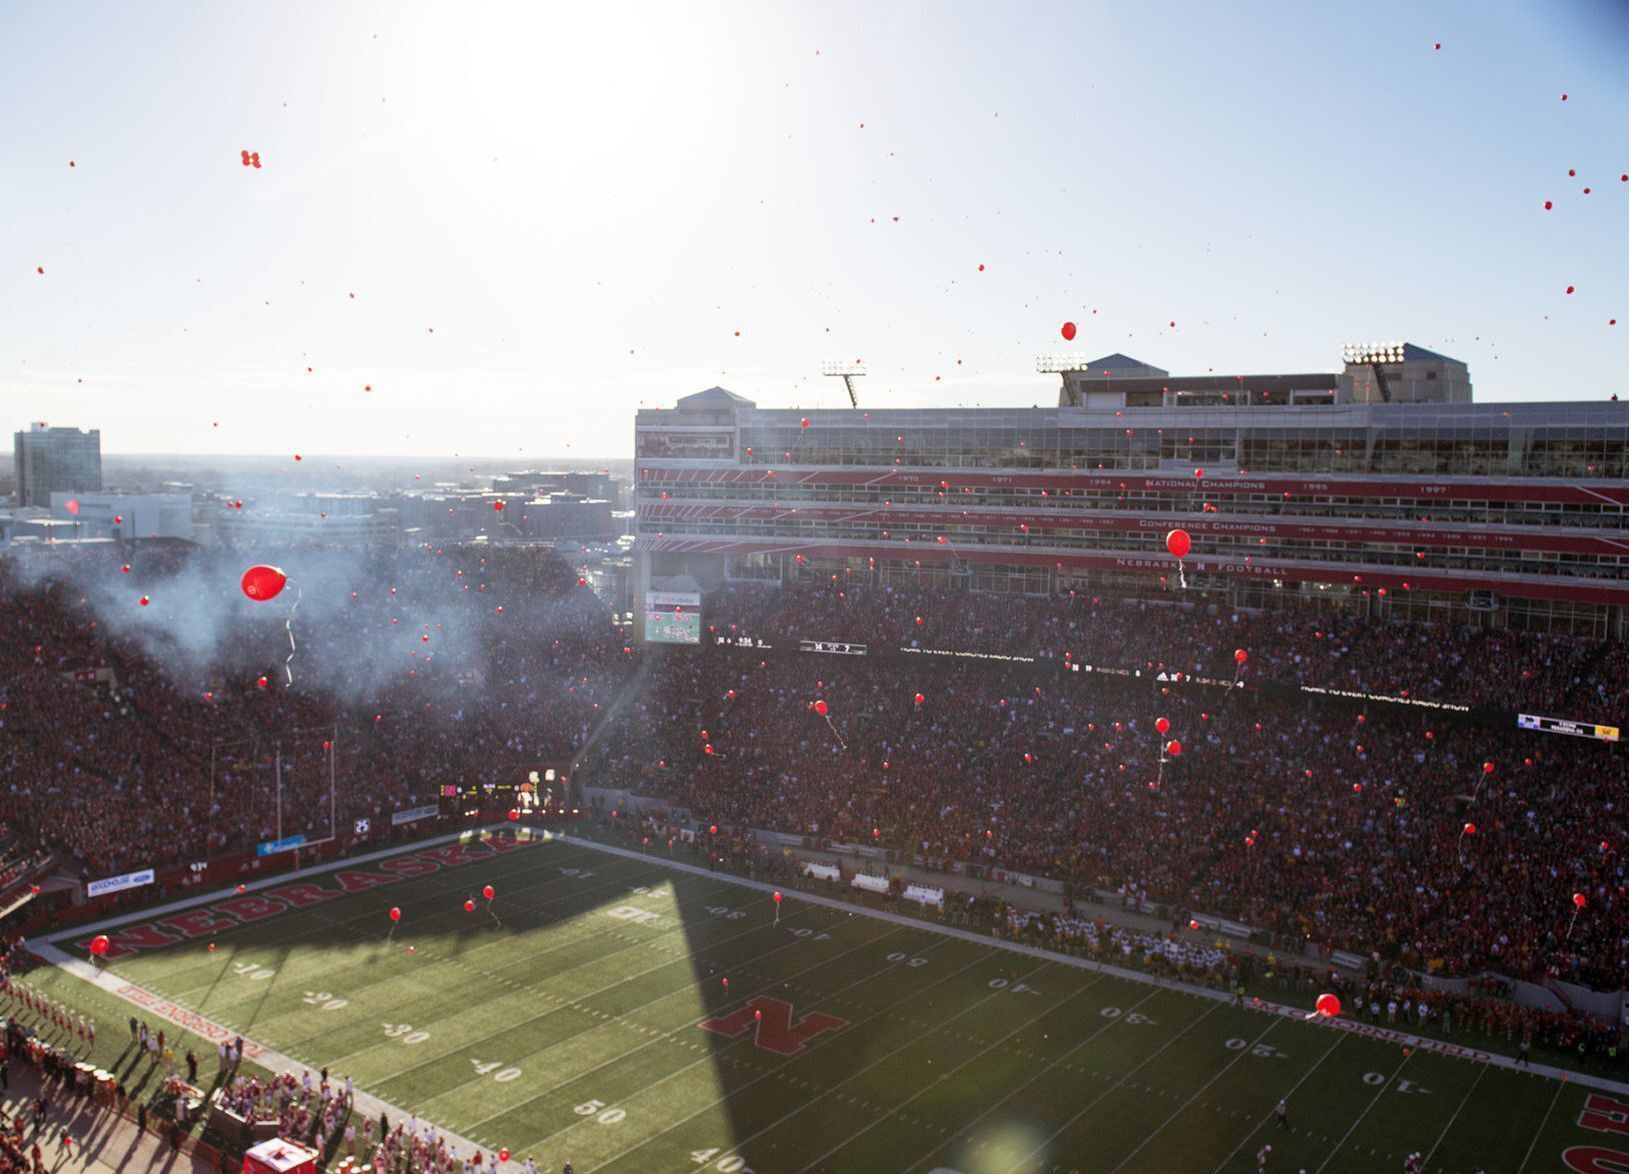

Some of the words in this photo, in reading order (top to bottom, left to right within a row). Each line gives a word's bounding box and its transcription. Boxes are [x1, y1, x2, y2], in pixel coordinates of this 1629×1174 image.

[1145, 479, 1198, 488] NATIONAL
[1202, 480, 1266, 490] CHAMPIONS
[1139, 519, 1208, 530] CONFERENCE
[1212, 522, 1276, 533] CHAMPIONS
[1218, 562, 1288, 575] FOOTBALL
[76, 836, 546, 961] NEBRASKA
[697, 995, 850, 1057] N
[574, 1099, 627, 1125] 50
